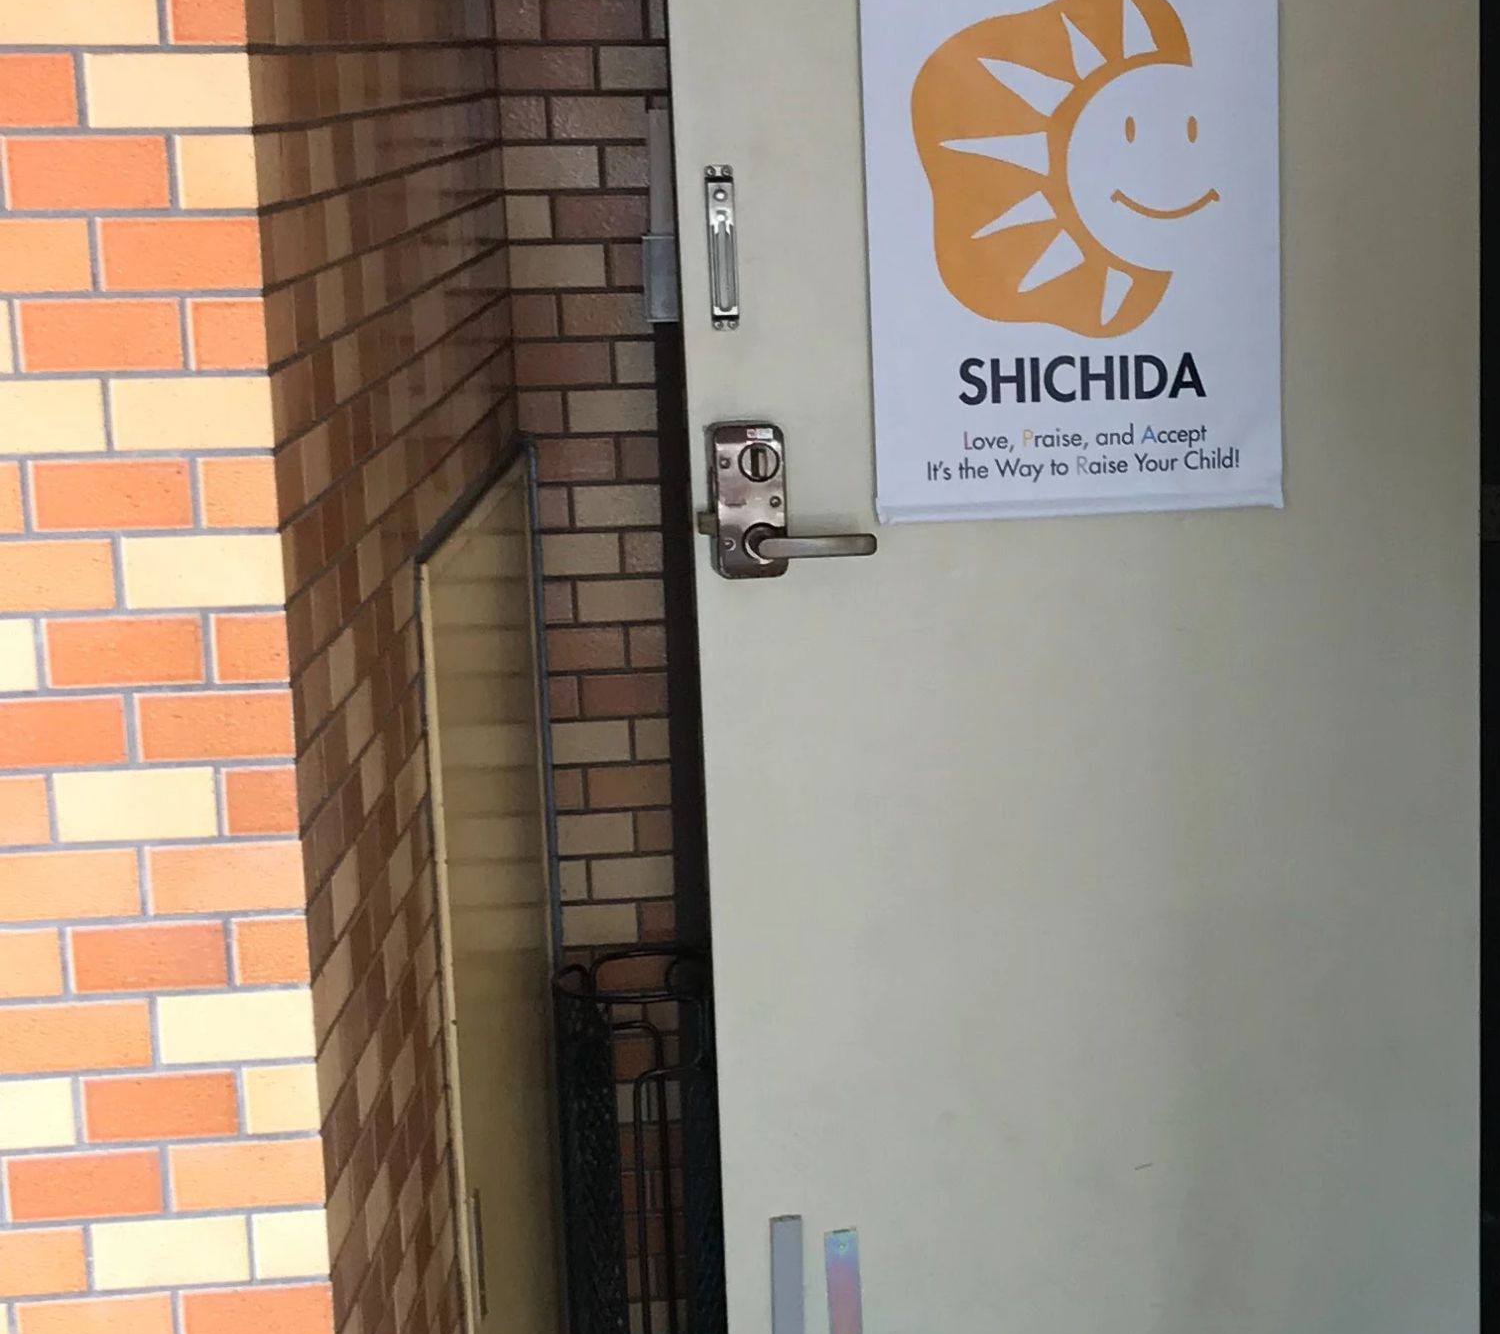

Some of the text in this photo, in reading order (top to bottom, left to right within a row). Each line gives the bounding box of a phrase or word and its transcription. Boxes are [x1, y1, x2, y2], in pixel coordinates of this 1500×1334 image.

[957, 351, 1207, 406] SHICHIDA
[963, 423, 1208, 453] Love, Praise, and Accept
[958, 457, 989, 480] the
[994, 457, 1044, 483] Way
[1050, 458, 1070, 476] to
[1076, 455, 1129, 476] Raise
[1134, 453, 1179, 473] Your
[1183, 446, 1240, 470] Child!
